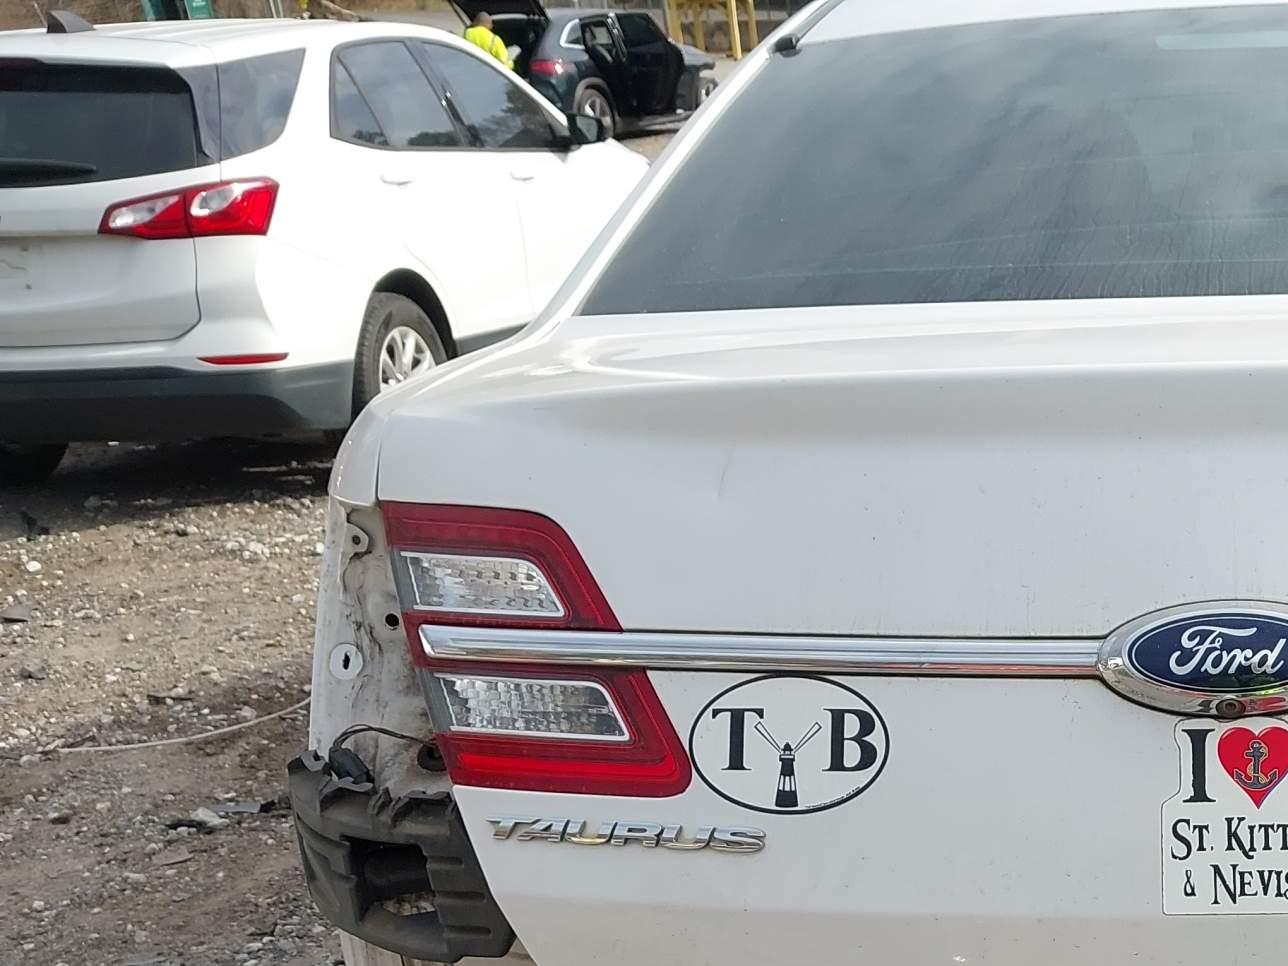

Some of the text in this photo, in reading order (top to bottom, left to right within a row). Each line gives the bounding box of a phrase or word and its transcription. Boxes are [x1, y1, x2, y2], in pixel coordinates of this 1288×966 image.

[1169, 626, 1287, 675] Ford
[1181, 728, 1217, 803] I
[486, 815, 767, 853] TAURUS
[1184, 869, 1196, 897] &
